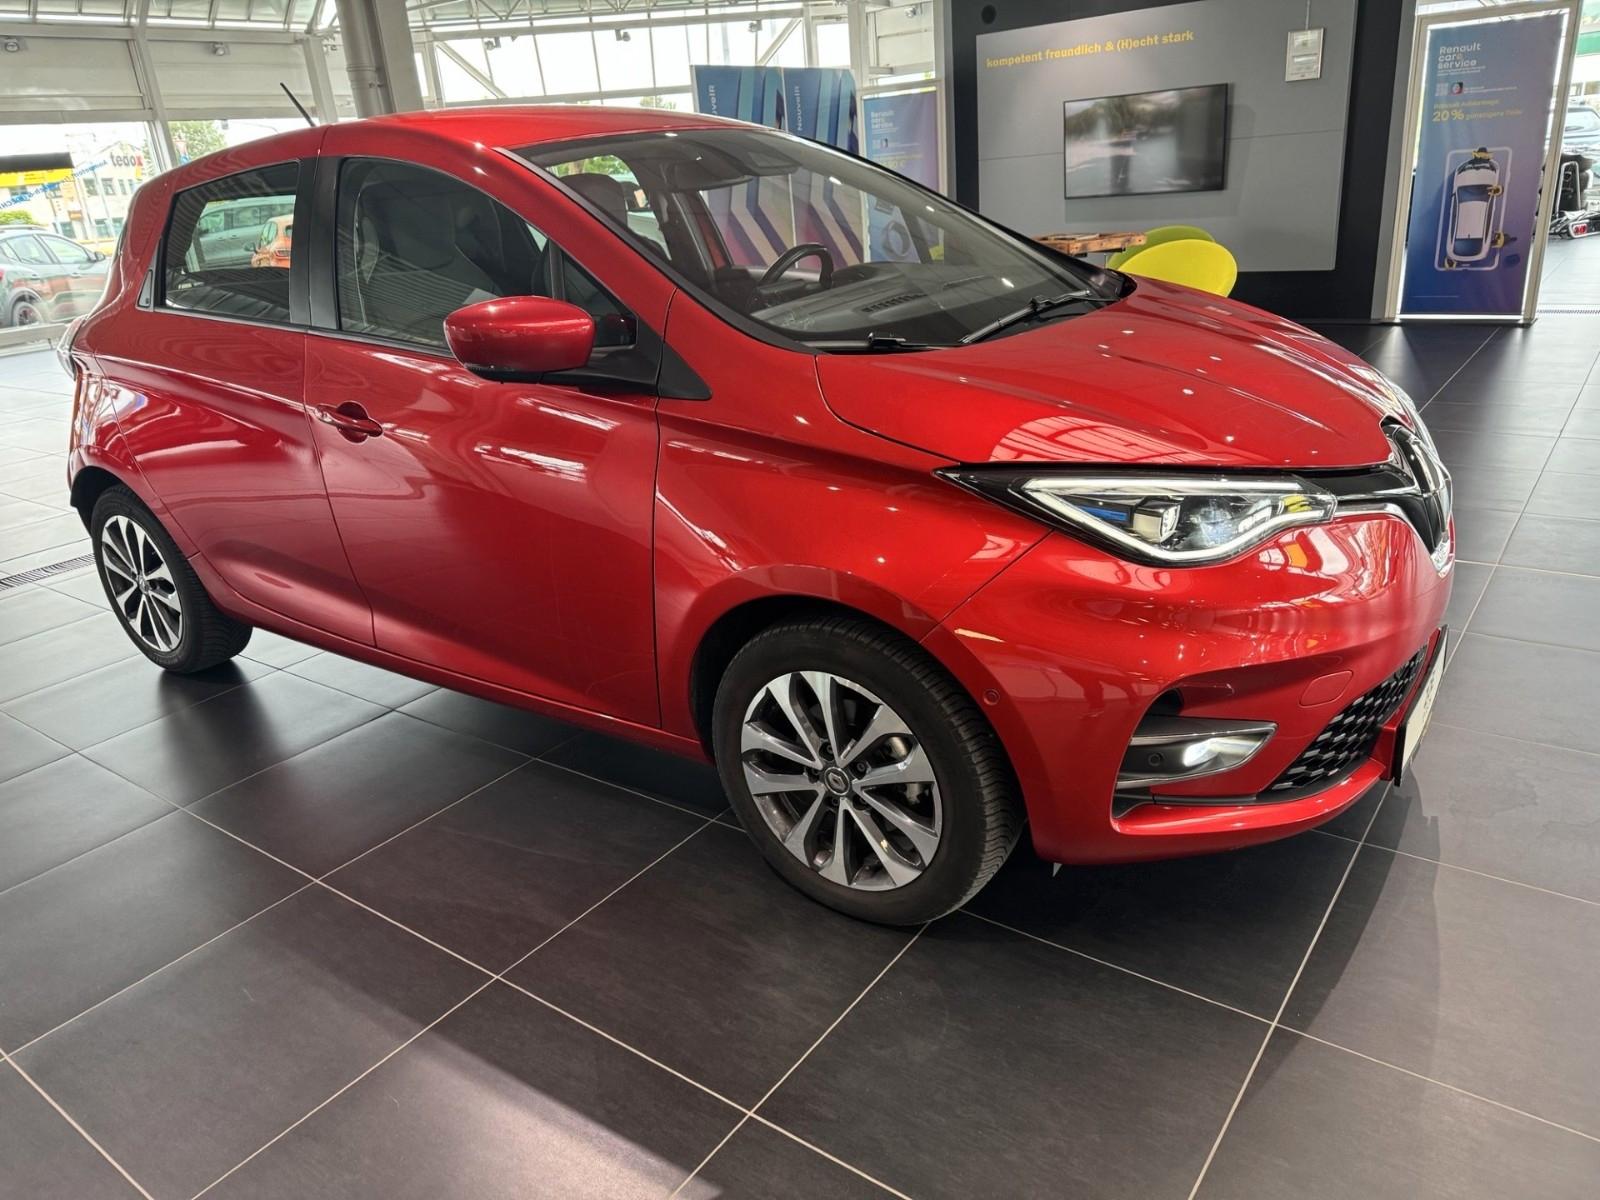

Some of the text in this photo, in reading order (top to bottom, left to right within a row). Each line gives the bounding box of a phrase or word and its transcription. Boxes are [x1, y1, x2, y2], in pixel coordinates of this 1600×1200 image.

[986, 51, 1042, 69] kompetent
[1045, 42, 1101, 59] freundlich
[1105, 40, 1114, 52] &
[1162, 30, 1194, 44] stark
[1440, 42, 1481, 54] Renault
[1438, 53, 1463, 62] care
[1438, 59, 1477, 69] service
[110, 152, 143, 167] tedox
